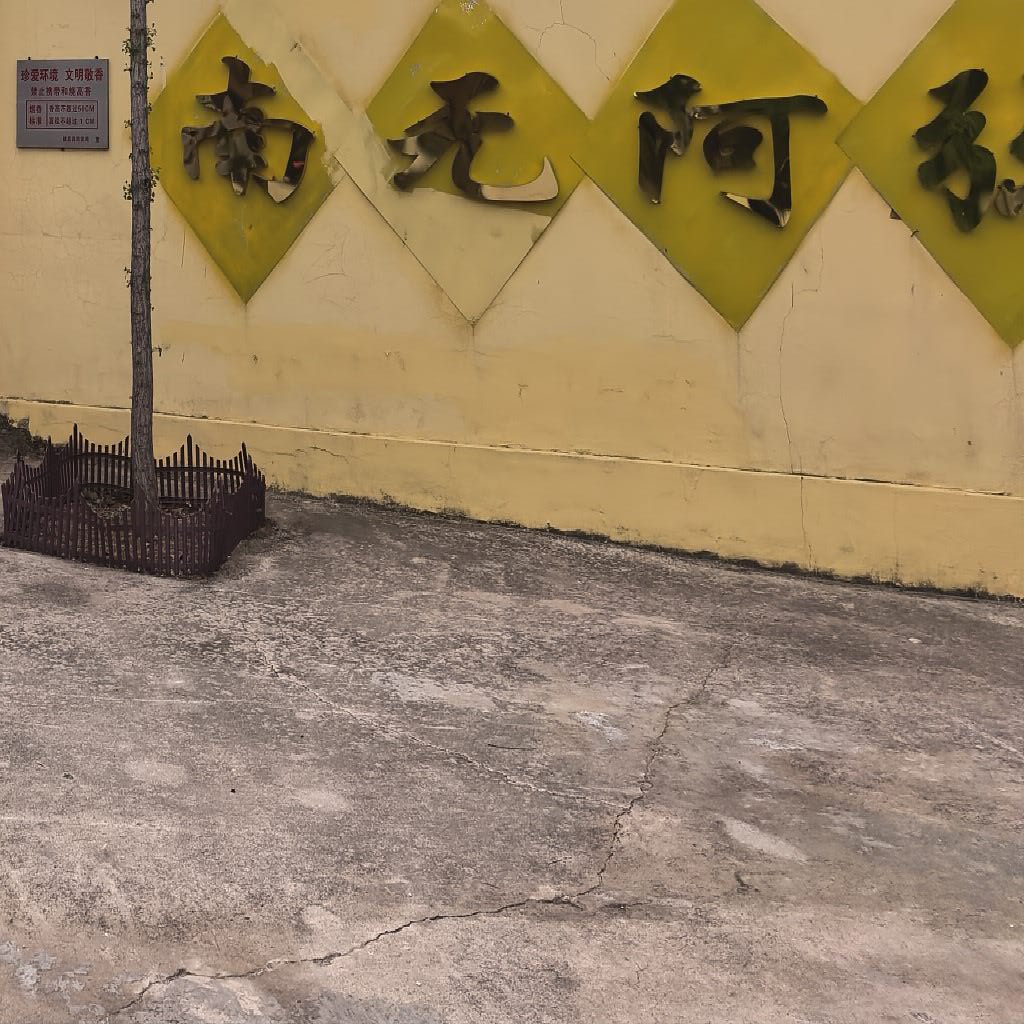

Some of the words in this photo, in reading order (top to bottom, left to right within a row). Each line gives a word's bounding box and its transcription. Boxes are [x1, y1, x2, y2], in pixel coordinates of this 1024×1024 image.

[21, 68, 59, 82] 珍爱环境
[65, 68, 104, 82] 文明敬香
